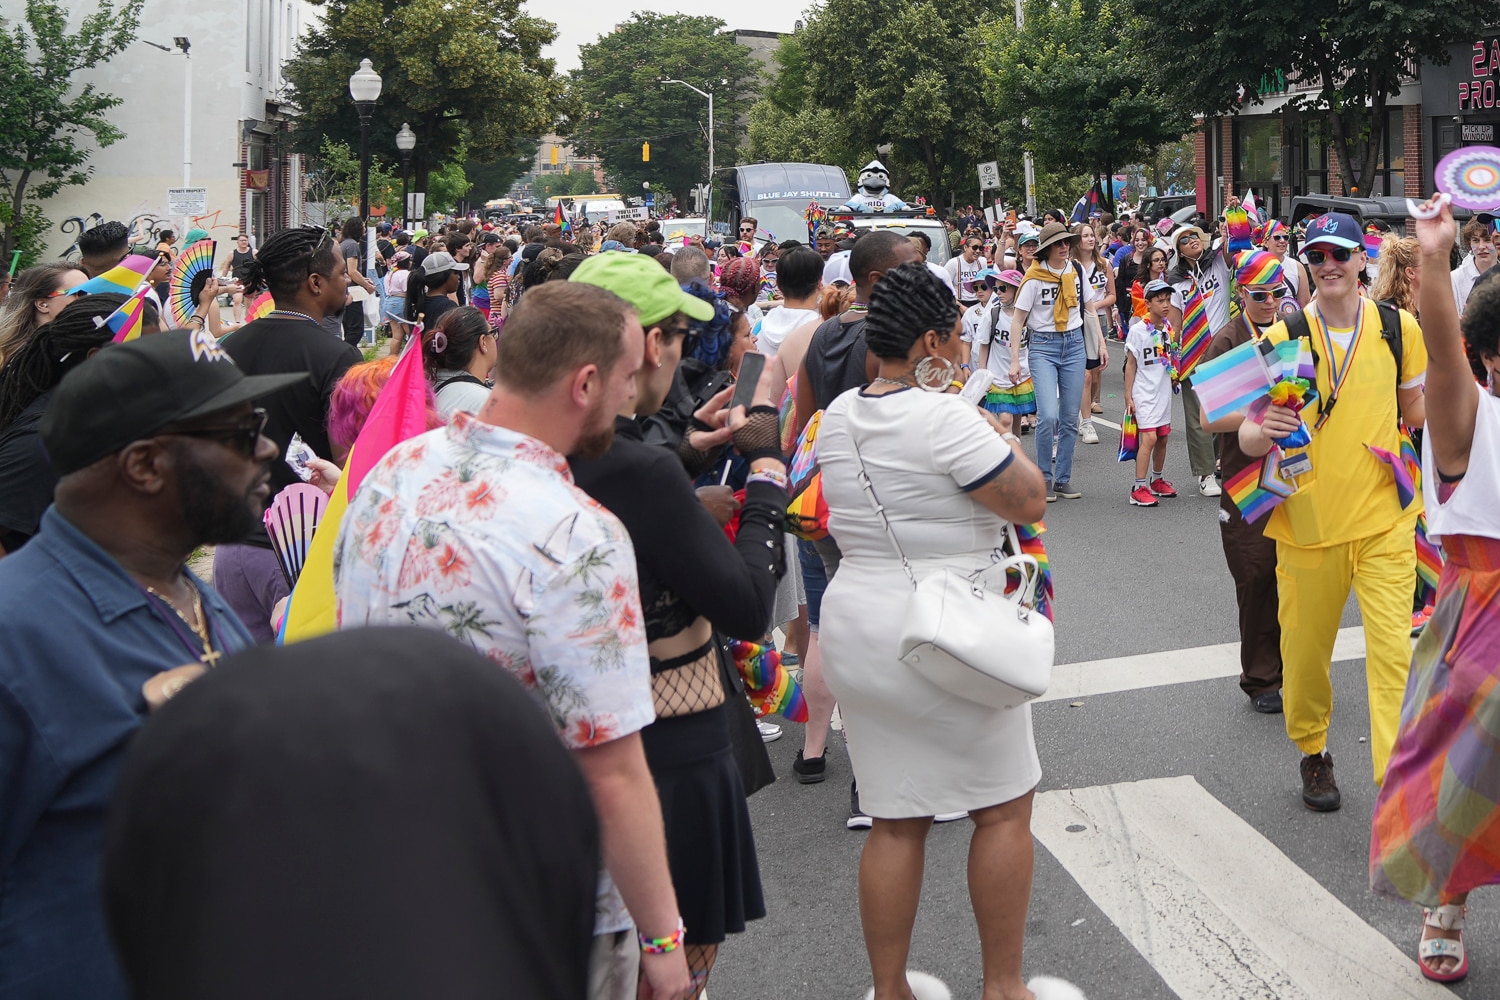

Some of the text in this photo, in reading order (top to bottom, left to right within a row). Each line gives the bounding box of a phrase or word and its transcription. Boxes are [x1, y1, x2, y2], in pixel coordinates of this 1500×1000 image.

[757, 192, 780, 200] BLUE
[800, 190, 841, 199] SHUTTLE
[960, 270, 978, 278] PRID
